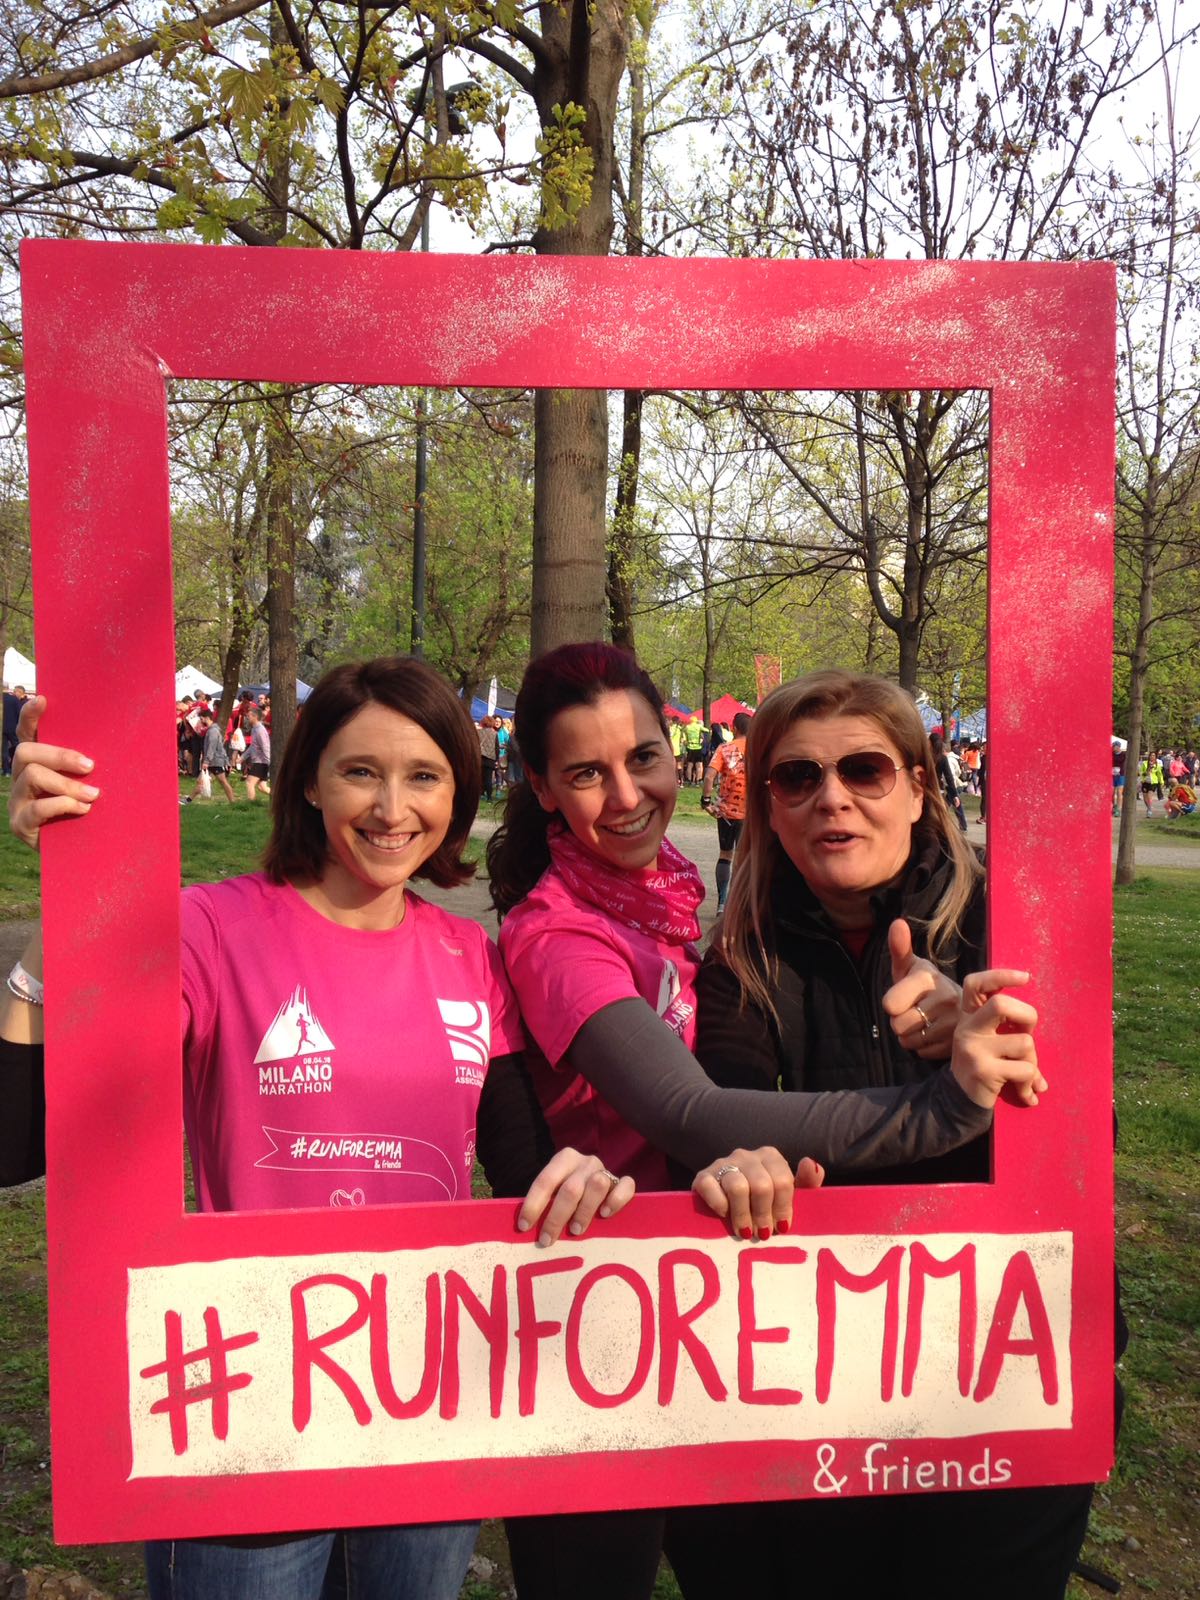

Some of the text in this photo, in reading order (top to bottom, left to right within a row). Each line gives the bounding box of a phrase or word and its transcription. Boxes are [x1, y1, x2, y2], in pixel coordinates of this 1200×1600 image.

[259, 1064, 332, 1083] MILANO
[259, 1082, 332, 1095] MARATHON
[290, 1136, 402, 1159] #RUNFOREMMA
[382, 1160, 402, 1169] friends
[139, 1241, 1059, 1455] #RUNFOREMMA
[813, 1442, 1012, 1493] & friends
